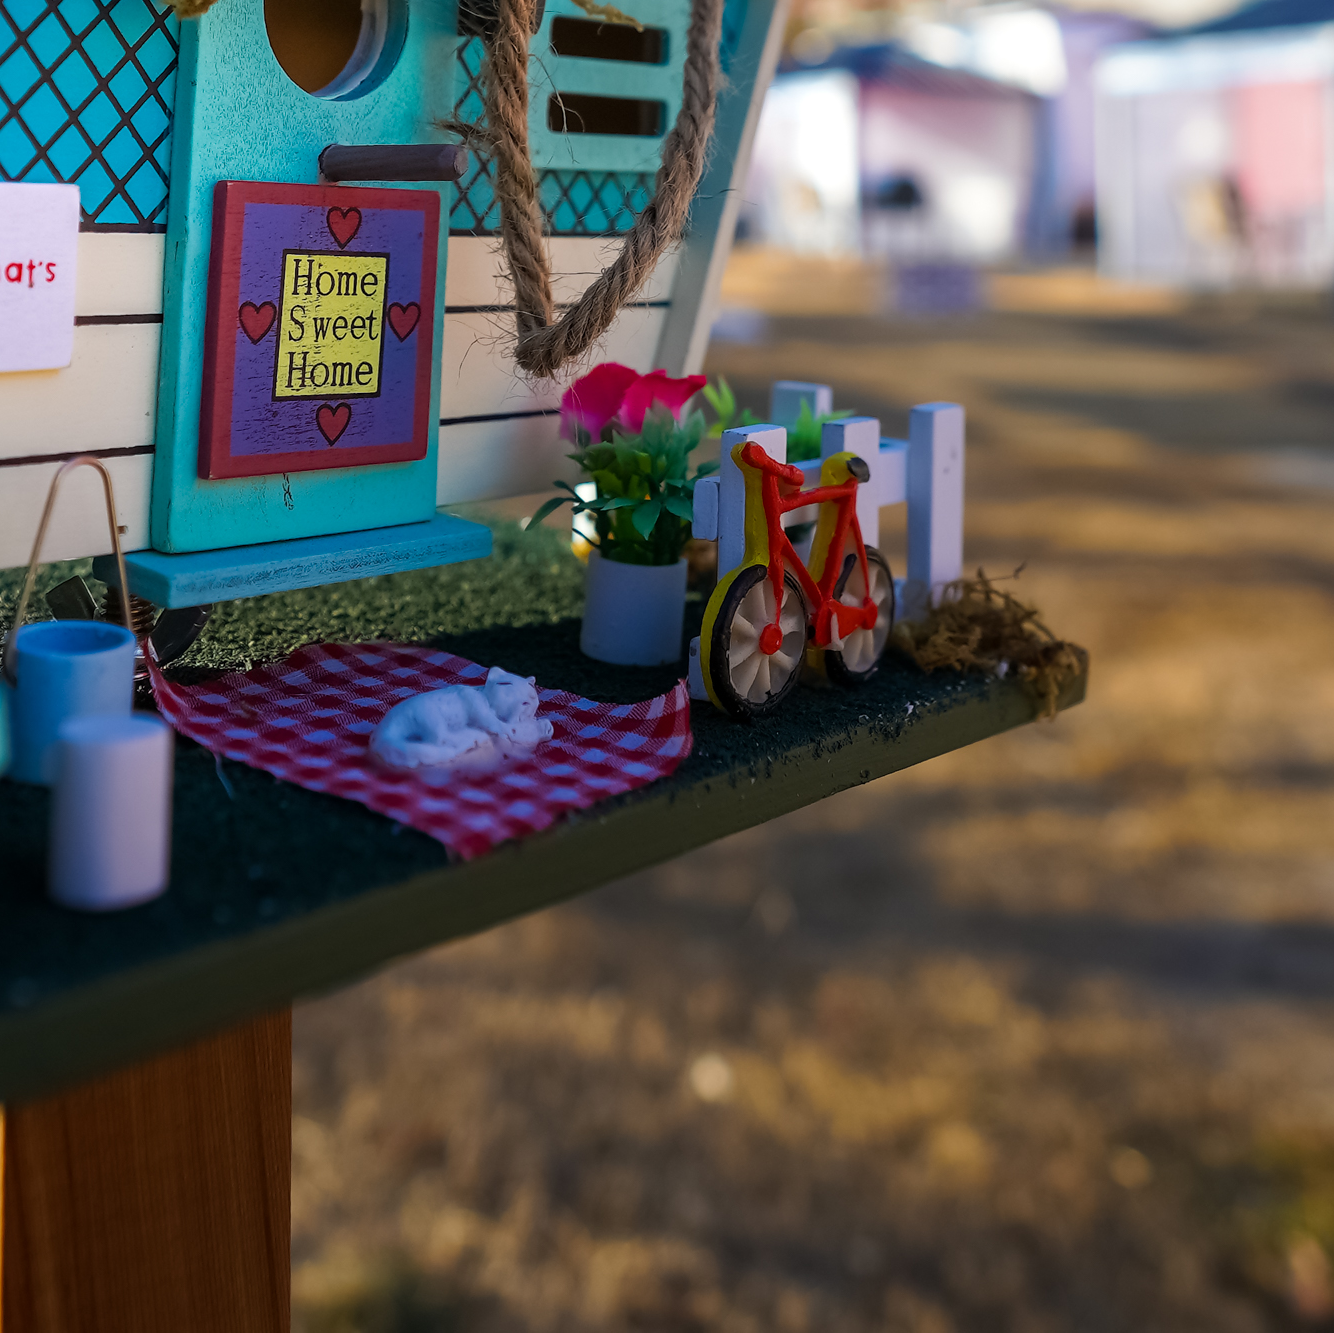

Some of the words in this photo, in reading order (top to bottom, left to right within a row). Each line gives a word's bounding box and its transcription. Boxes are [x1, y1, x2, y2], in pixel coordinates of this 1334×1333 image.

[291, 258, 379, 297] Home
[287, 304, 379, 342] Sweet
[284, 351, 374, 388] Home
